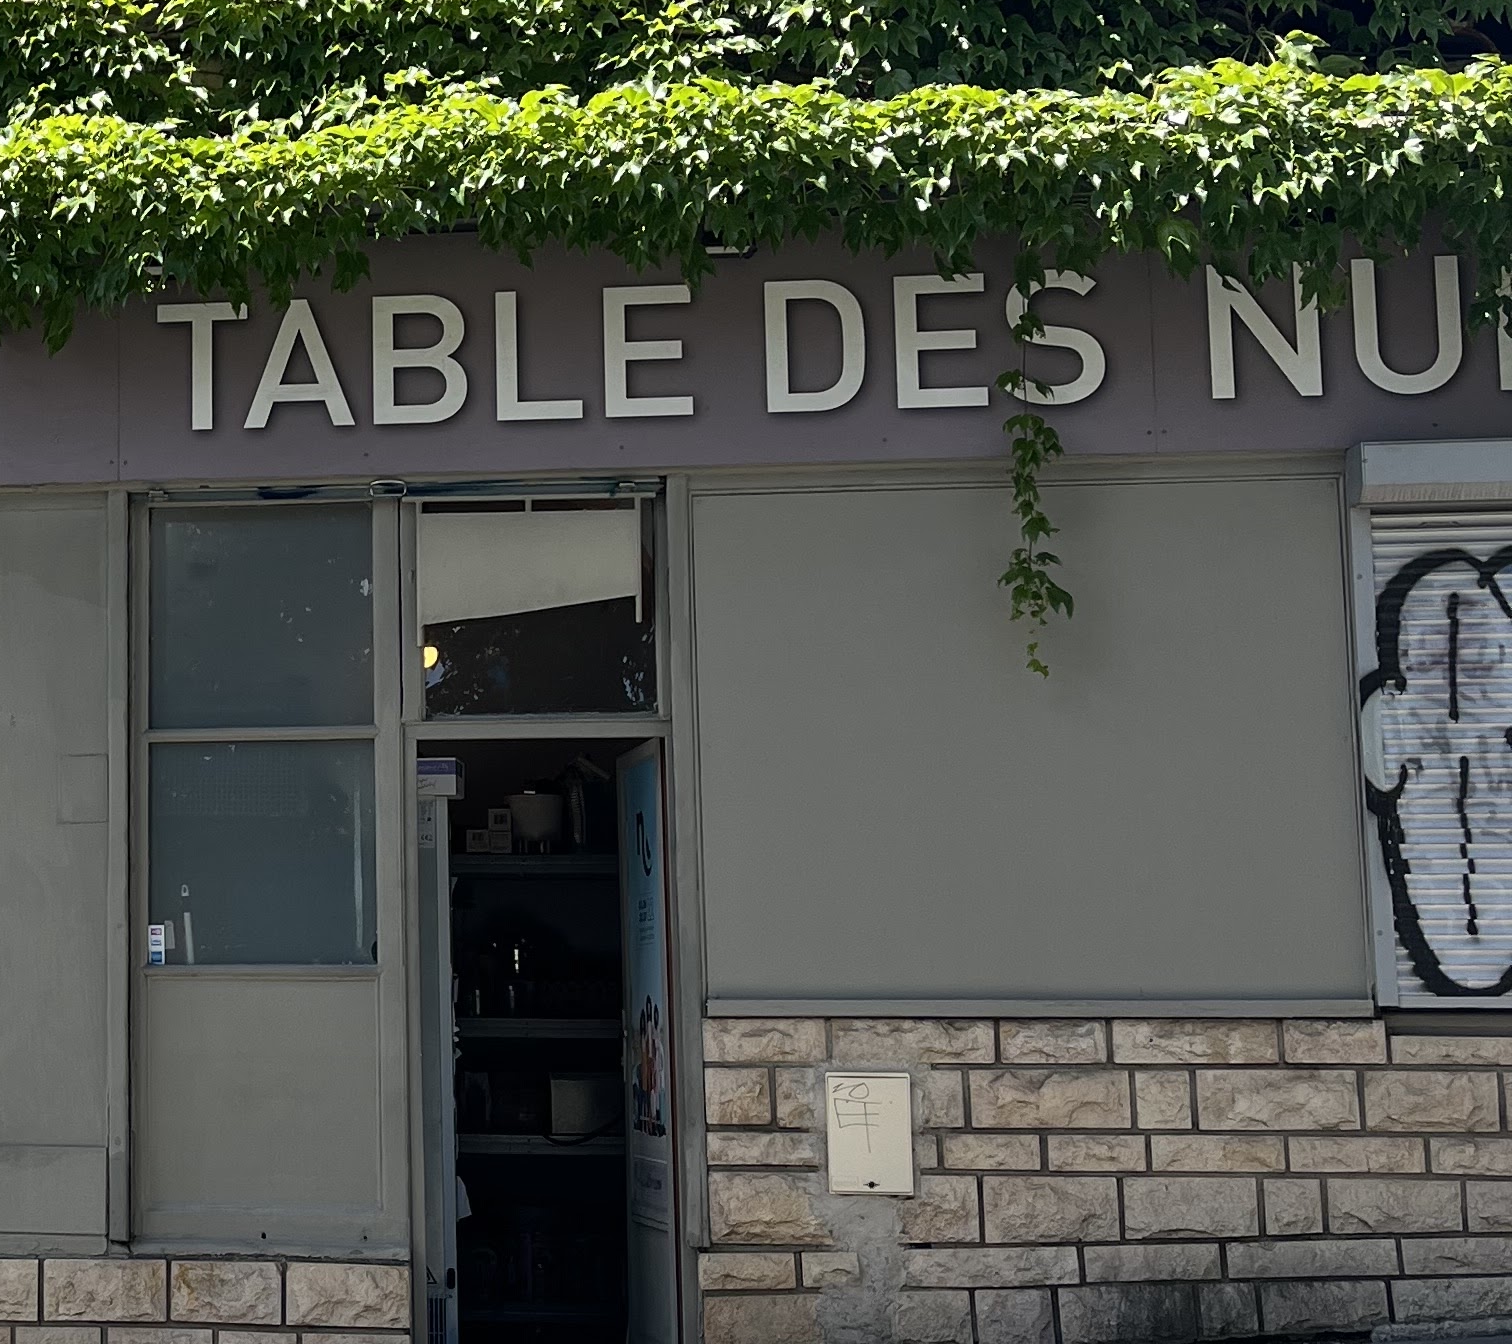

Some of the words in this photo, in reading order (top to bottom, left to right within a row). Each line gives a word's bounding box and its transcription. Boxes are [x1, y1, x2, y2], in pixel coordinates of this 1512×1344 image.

[156, 283, 694, 431] TABLE
[763, 268, 1106, 414] DES
[1205, 254, 1512, 400] NU
